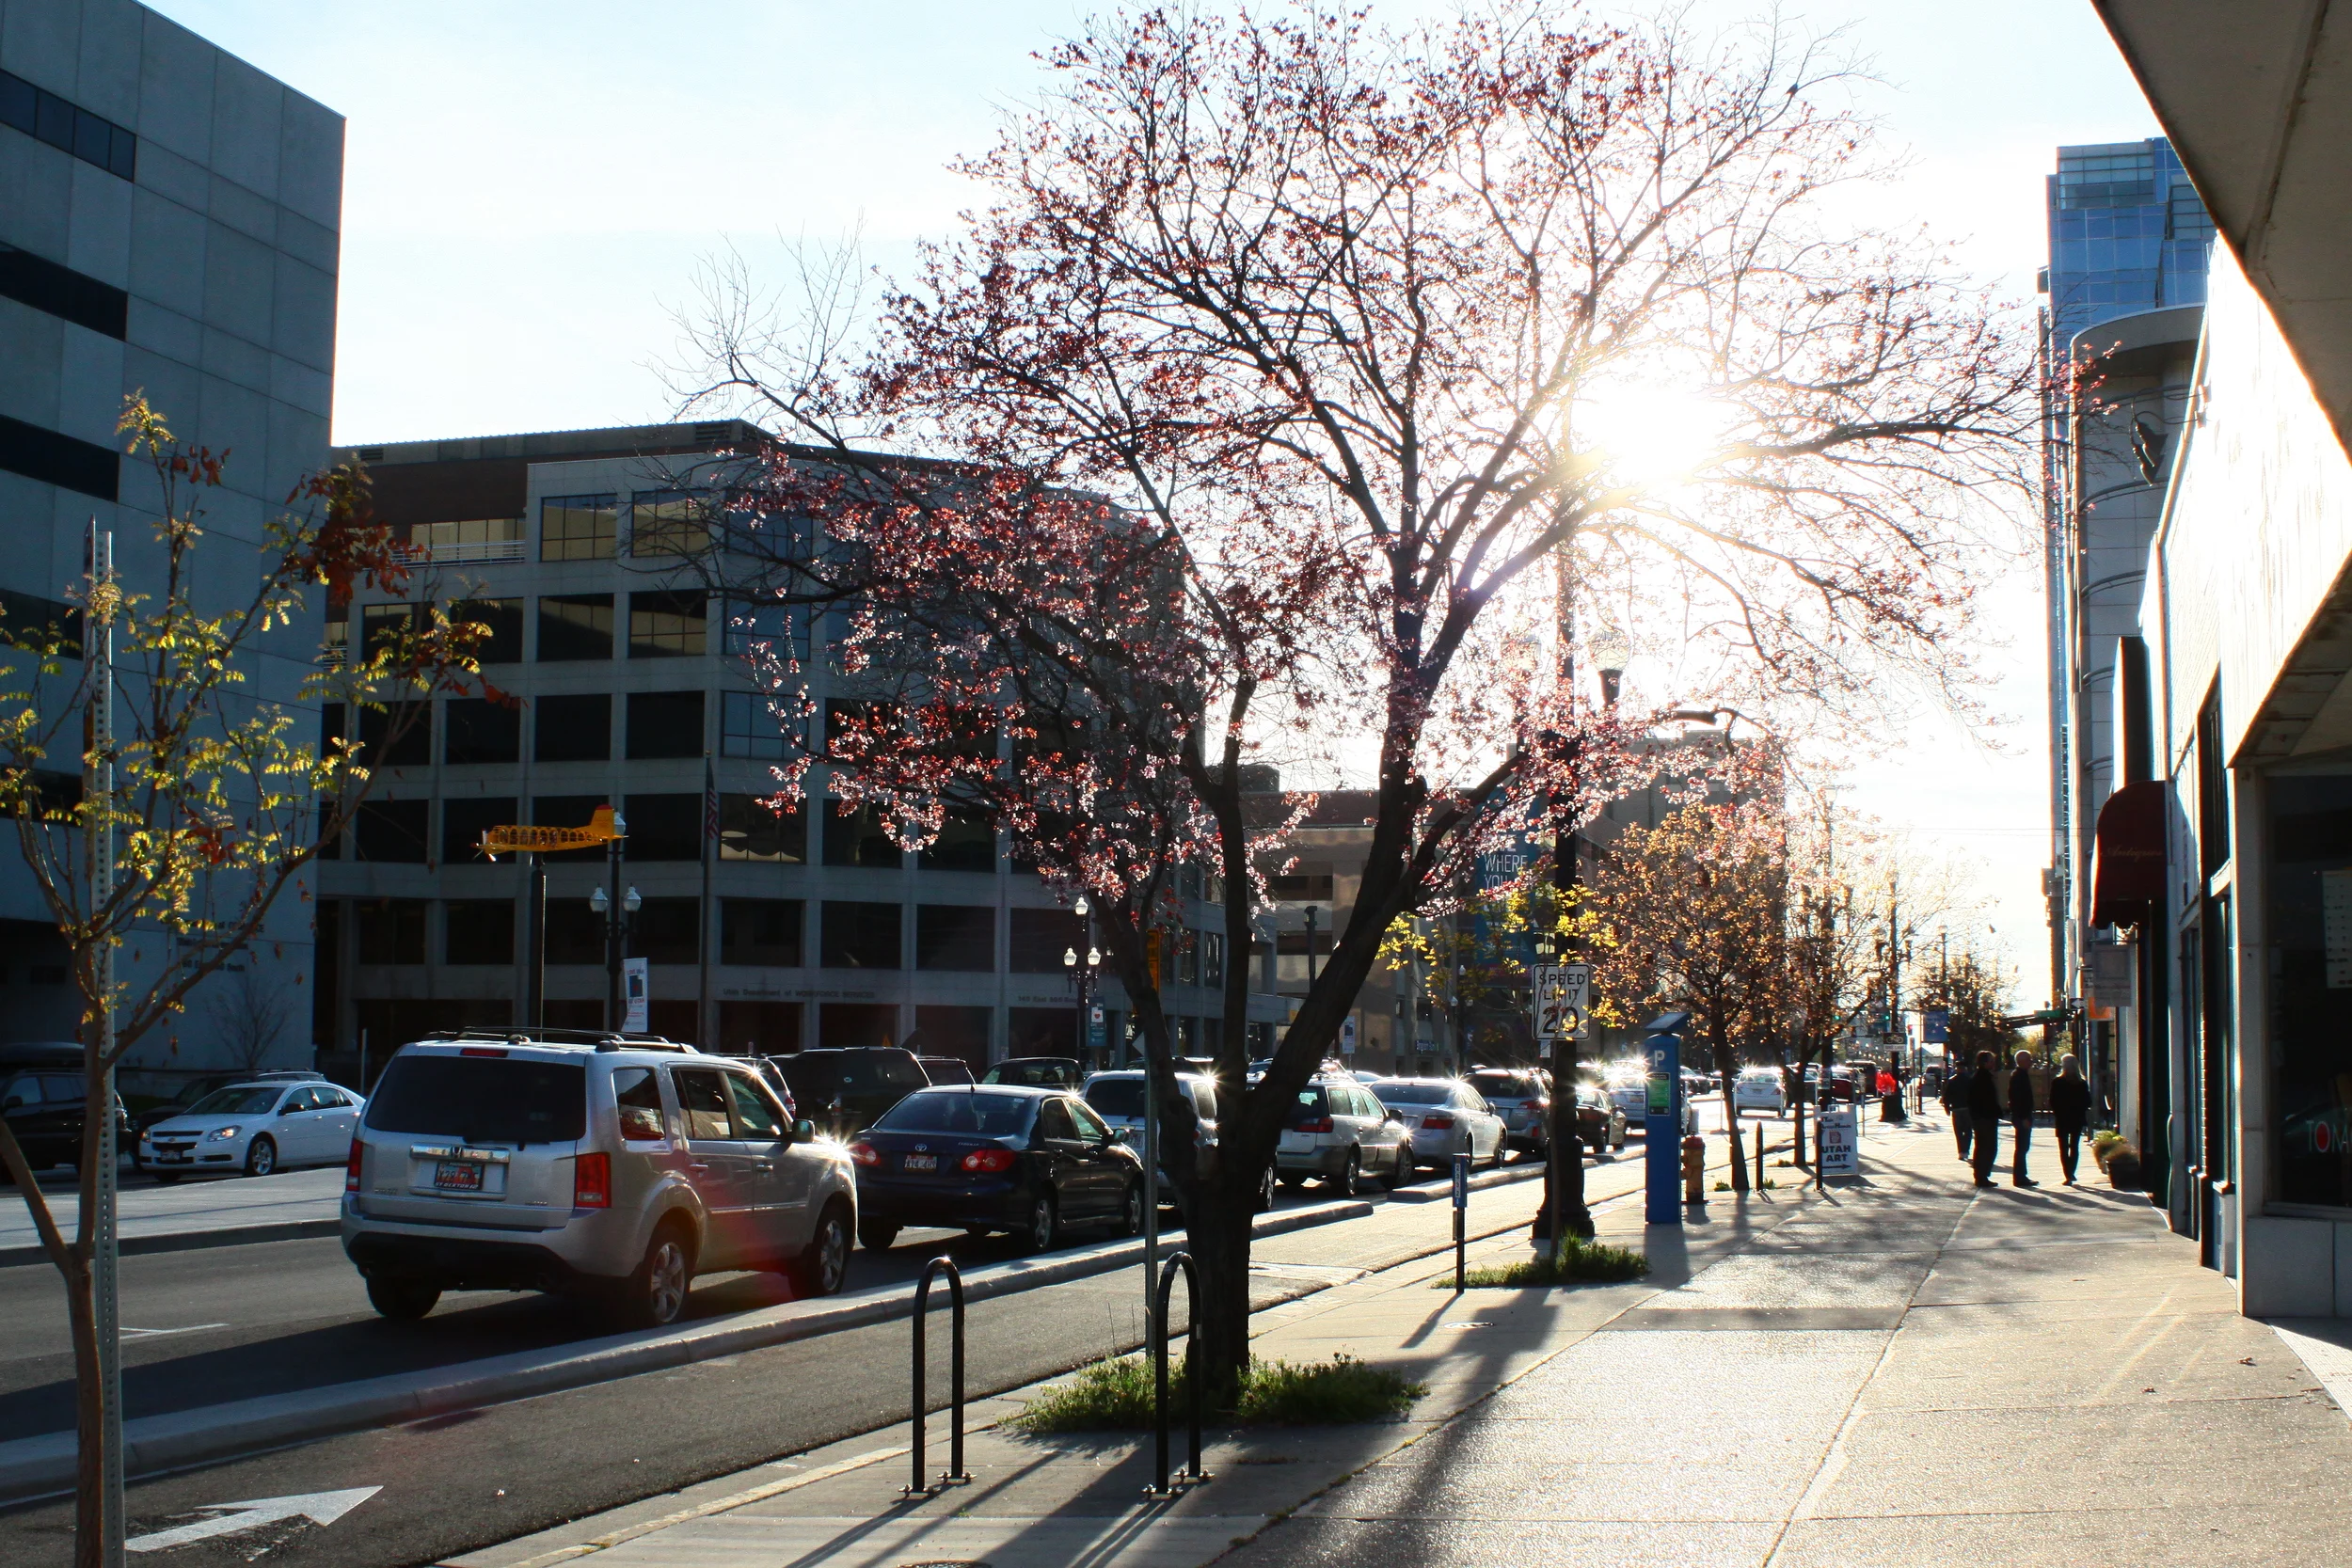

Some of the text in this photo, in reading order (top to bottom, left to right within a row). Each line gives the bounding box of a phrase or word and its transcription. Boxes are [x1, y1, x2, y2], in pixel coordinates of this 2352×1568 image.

[2106, 844, 2163, 863] Antiques
[1484, 854, 1528, 873] WHERE
[1539, 974, 1585, 985] SPEED
[1543, 1006, 1579, 1033] 20
[1654, 1050, 1665, 1067] P
[2305, 1120, 2352, 1153] TOM
[1820, 1145, 1851, 1153] UTAH
